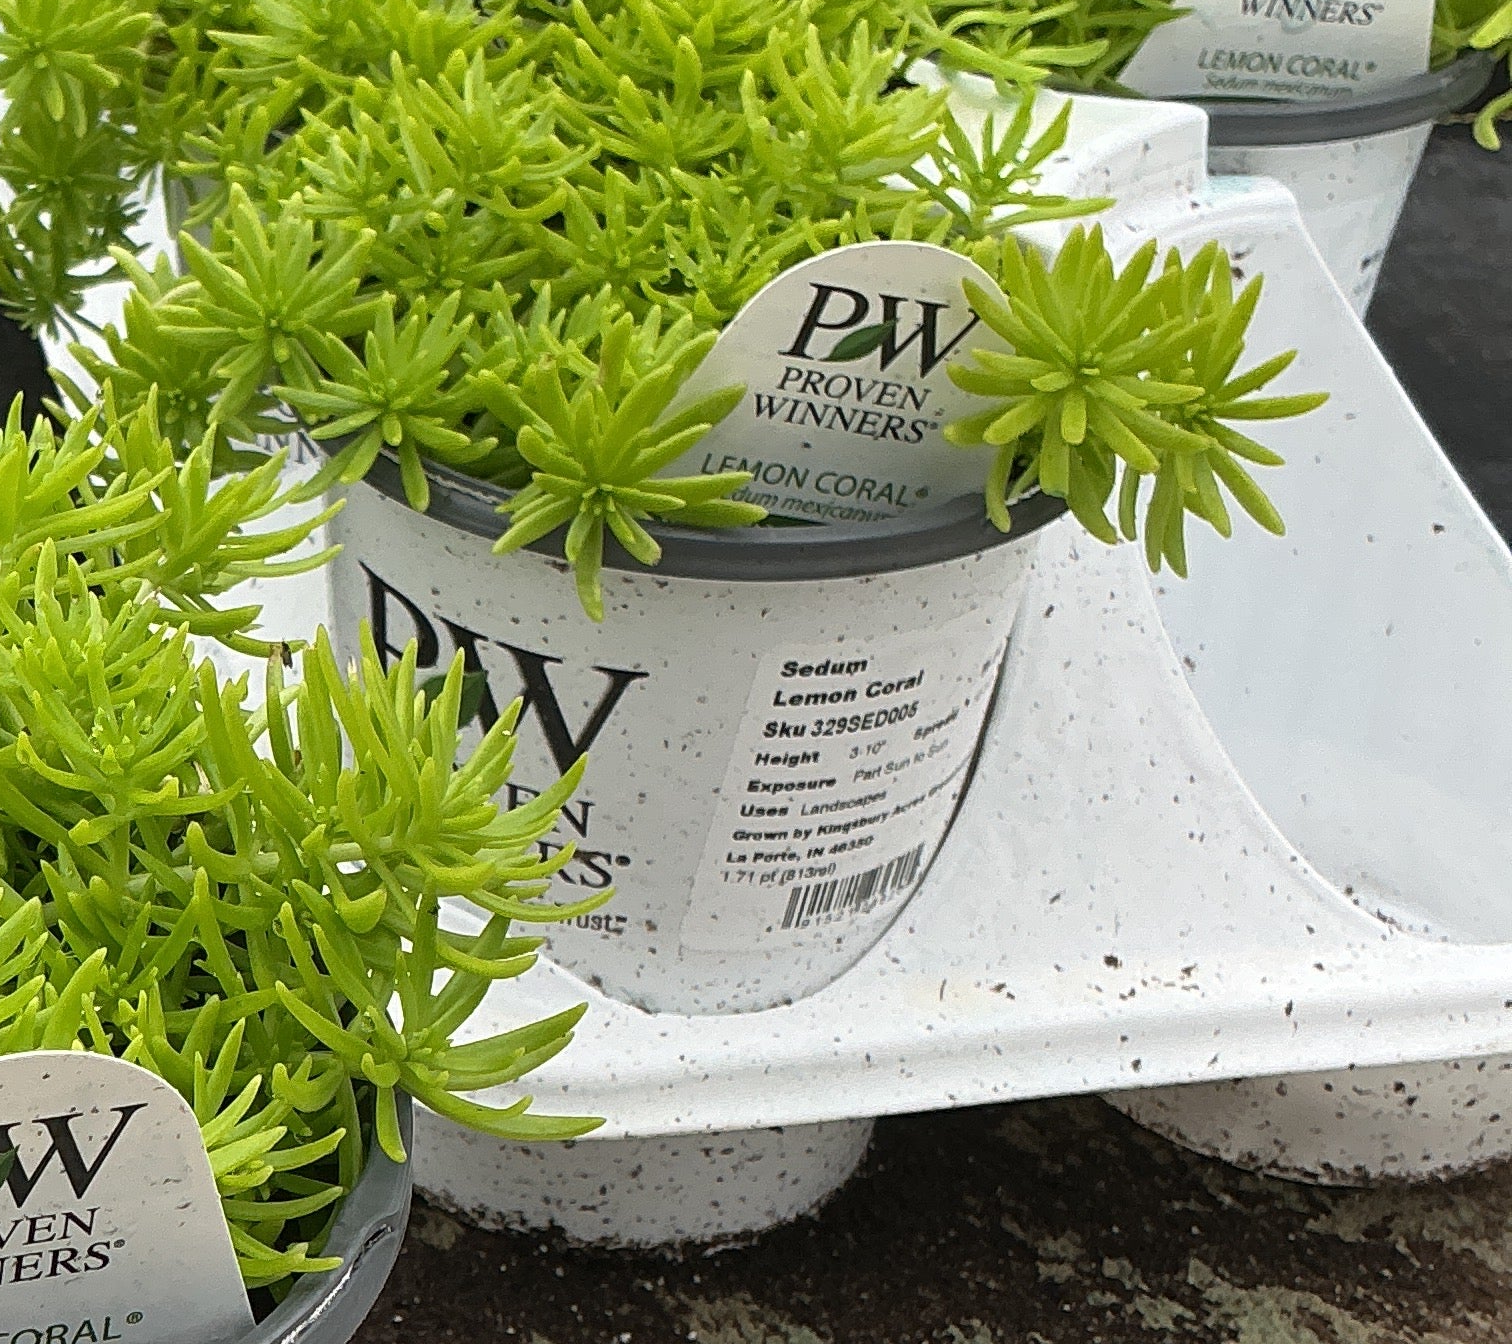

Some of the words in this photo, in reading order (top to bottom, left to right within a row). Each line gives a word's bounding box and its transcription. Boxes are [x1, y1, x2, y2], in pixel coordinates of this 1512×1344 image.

[1196, 47, 1284, 74] LEMON
[776, 281, 982, 380] PW
[775, 365, 932, 413] PROVEN
[700, 452, 810, 490] LEMON
[779, 658, 869, 679] Sedum
[771, 686, 859, 708] Lemon
[864, 669, 926, 700] Coral
[762, 720, 807, 740] Sku
[810, 700, 921, 738] 329SED005
[753, 750, 821, 768] Height
[745, 776, 838, 795] Exposure
[852, 766, 882, 784] Part
[739, 803, 790, 818] Uses
[799, 789, 888, 817] Landscapes
[731, 829, 789, 842] Grown
[792, 826, 814, 842] by
[816, 811, 889, 837] Kingsbury
[725, 850, 748, 864] La
[806, 846, 826, 860] IN
